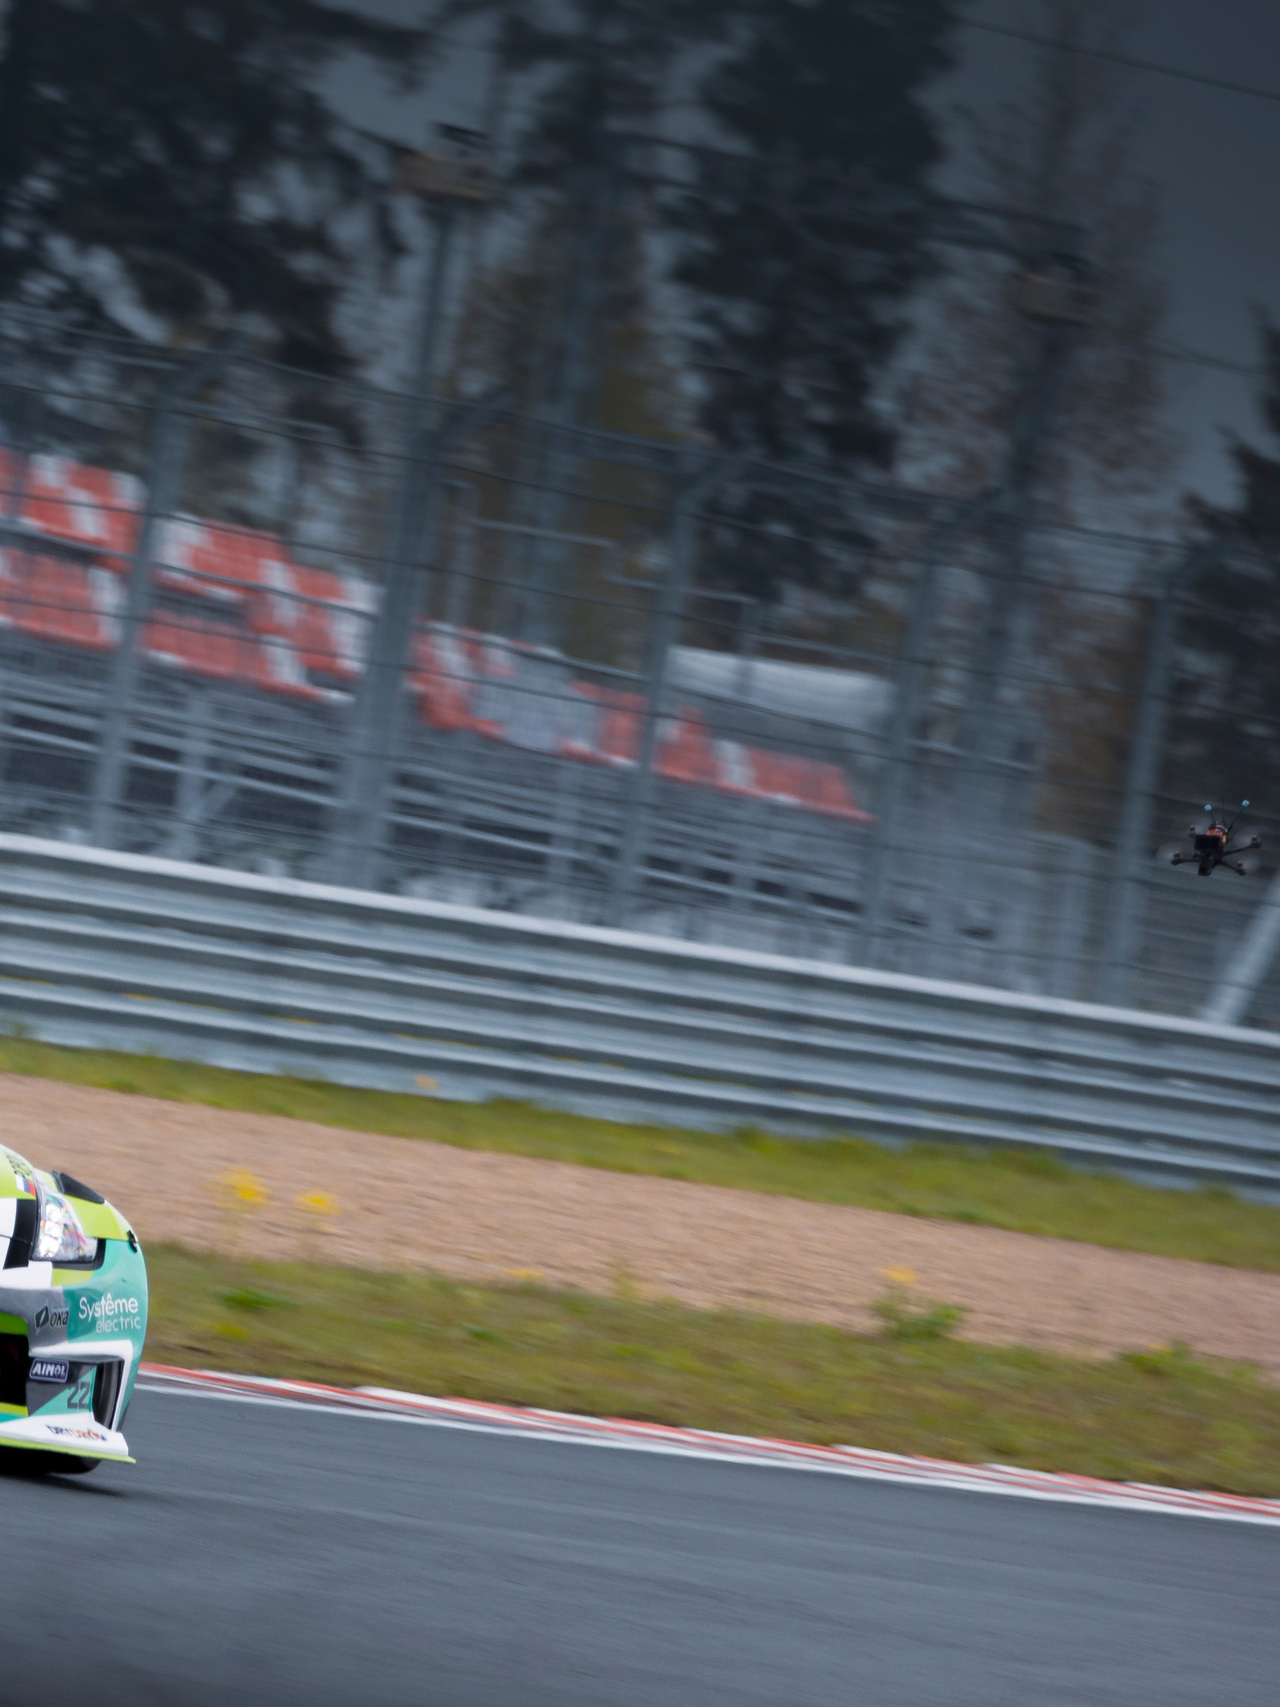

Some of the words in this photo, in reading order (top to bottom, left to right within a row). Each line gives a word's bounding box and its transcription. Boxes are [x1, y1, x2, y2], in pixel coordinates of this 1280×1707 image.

[78, 1292, 139, 1322] Système
[96, 1315, 141, 1334] electric
[32, 1363, 66, 1377] AIMOL
[67, 1382, 90, 1409] 22
